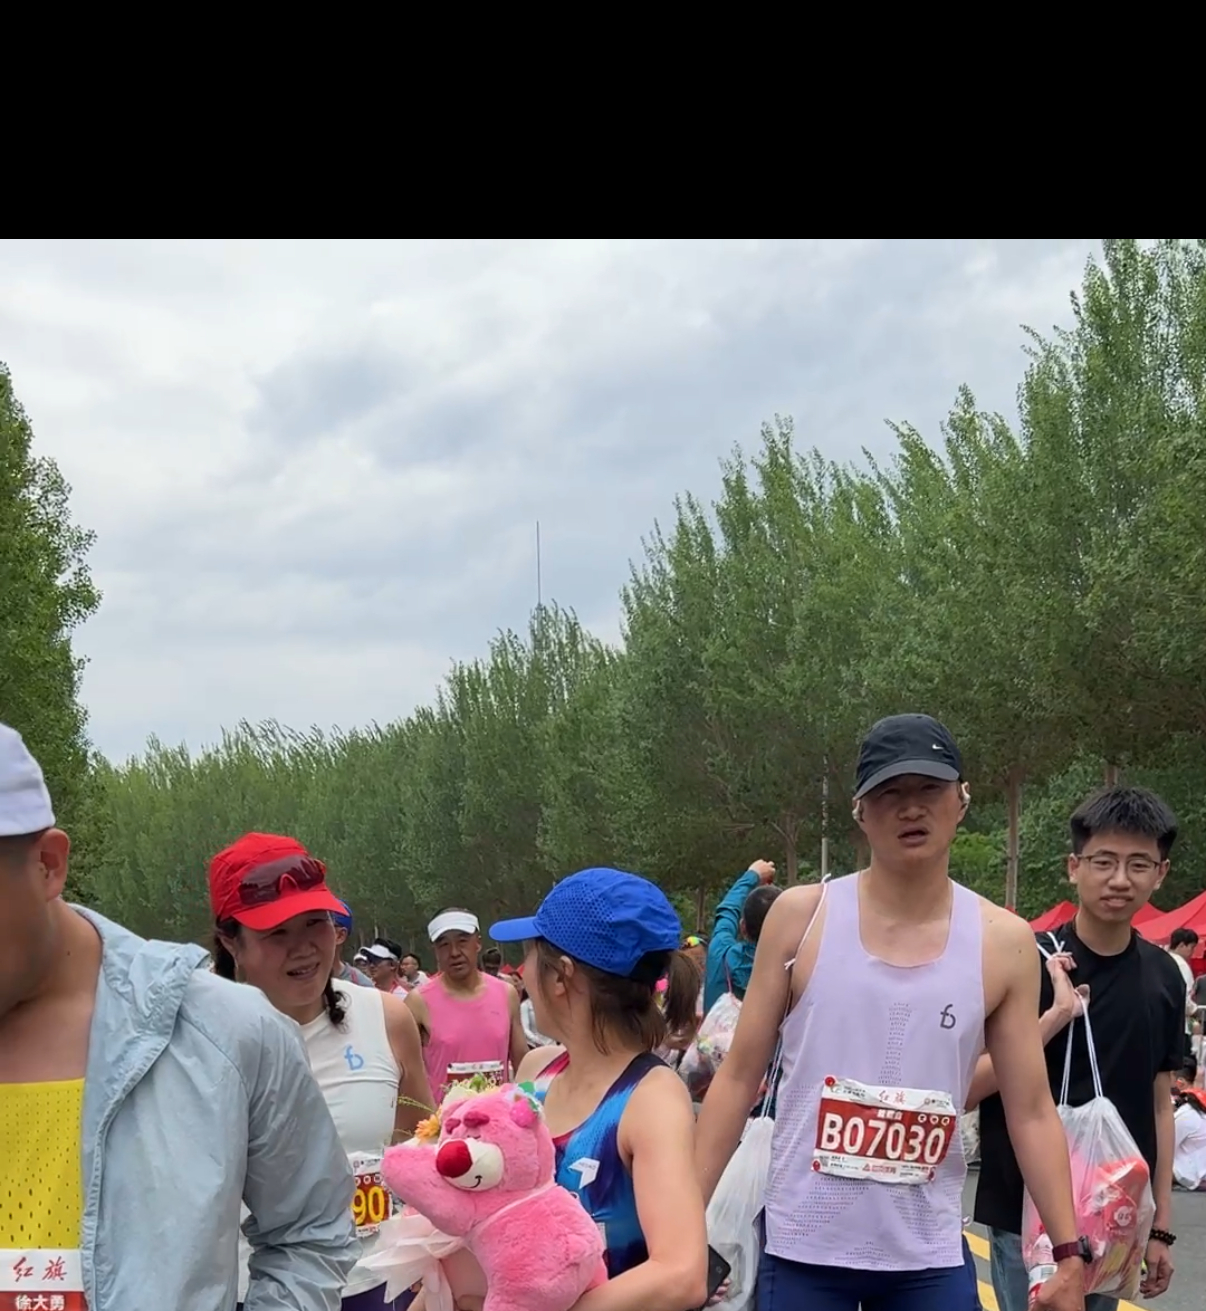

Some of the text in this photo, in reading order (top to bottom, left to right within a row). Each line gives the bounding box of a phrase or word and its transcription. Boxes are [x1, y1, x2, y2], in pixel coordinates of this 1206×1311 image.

[820, 1111, 946, 1165] B07030
[13, 1255, 68, 1282] 红旗
[15, 1294, 66, 1311] 徐大勇
